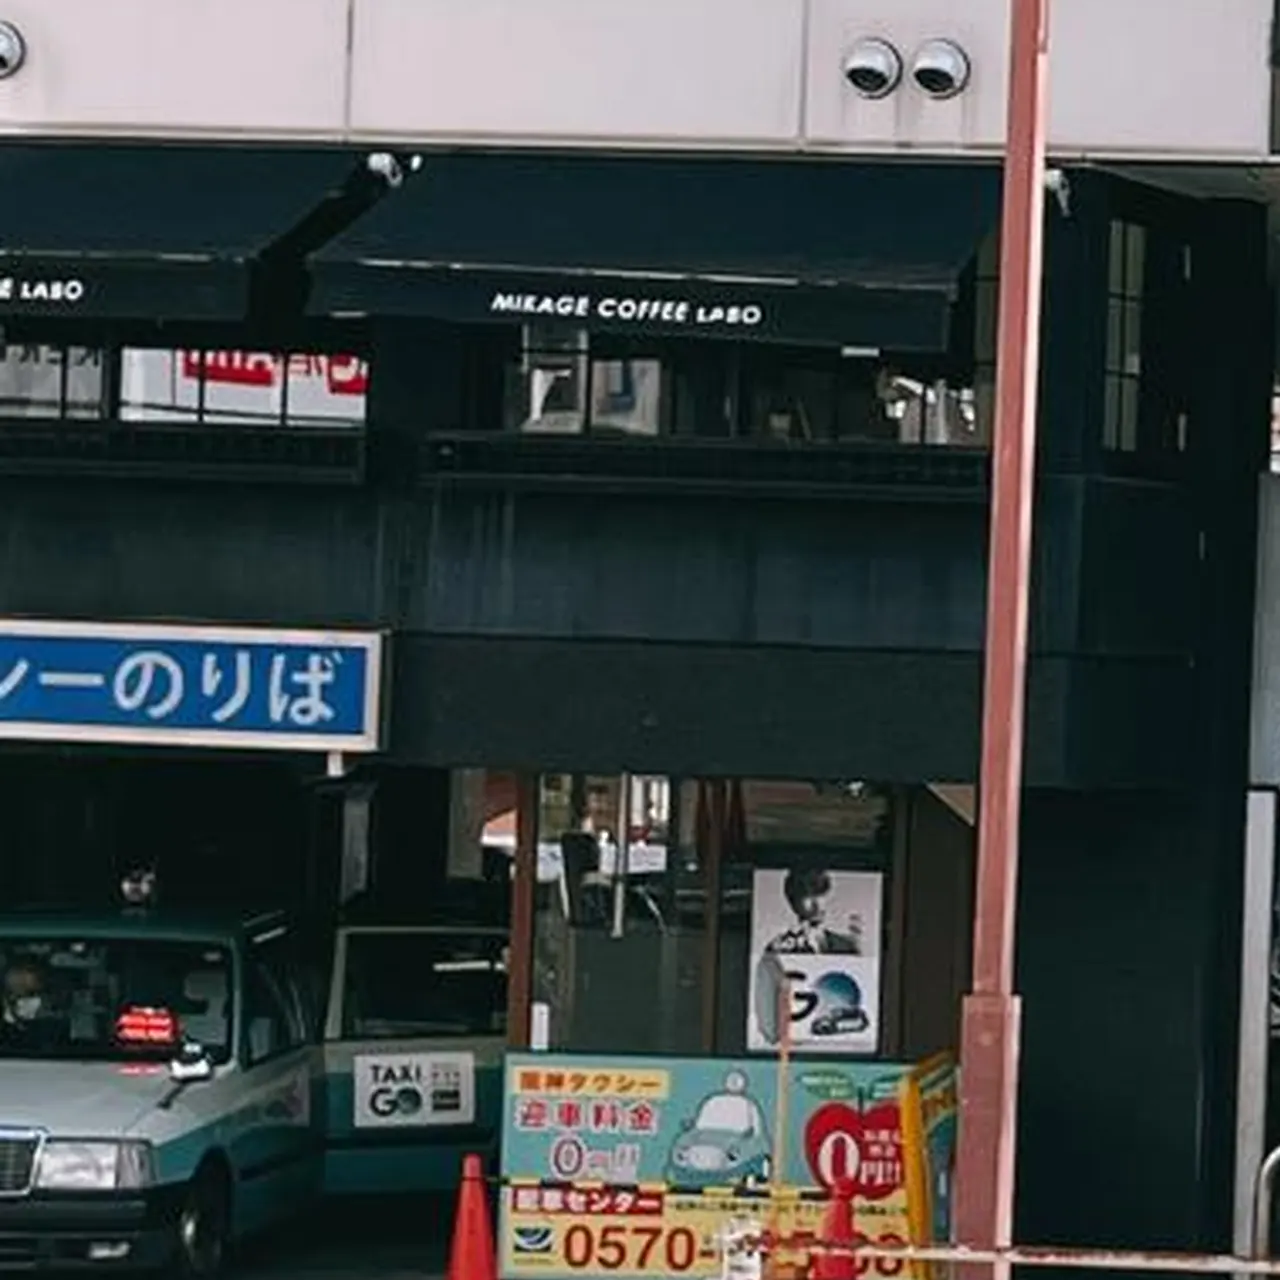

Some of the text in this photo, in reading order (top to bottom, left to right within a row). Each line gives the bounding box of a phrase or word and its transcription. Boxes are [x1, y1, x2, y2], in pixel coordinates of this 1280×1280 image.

[21, 280, 83, 301] LABO
[491, 294, 762, 325] MIKAGE COFFEE LABO
[370, 1064, 422, 1082] TAXI
